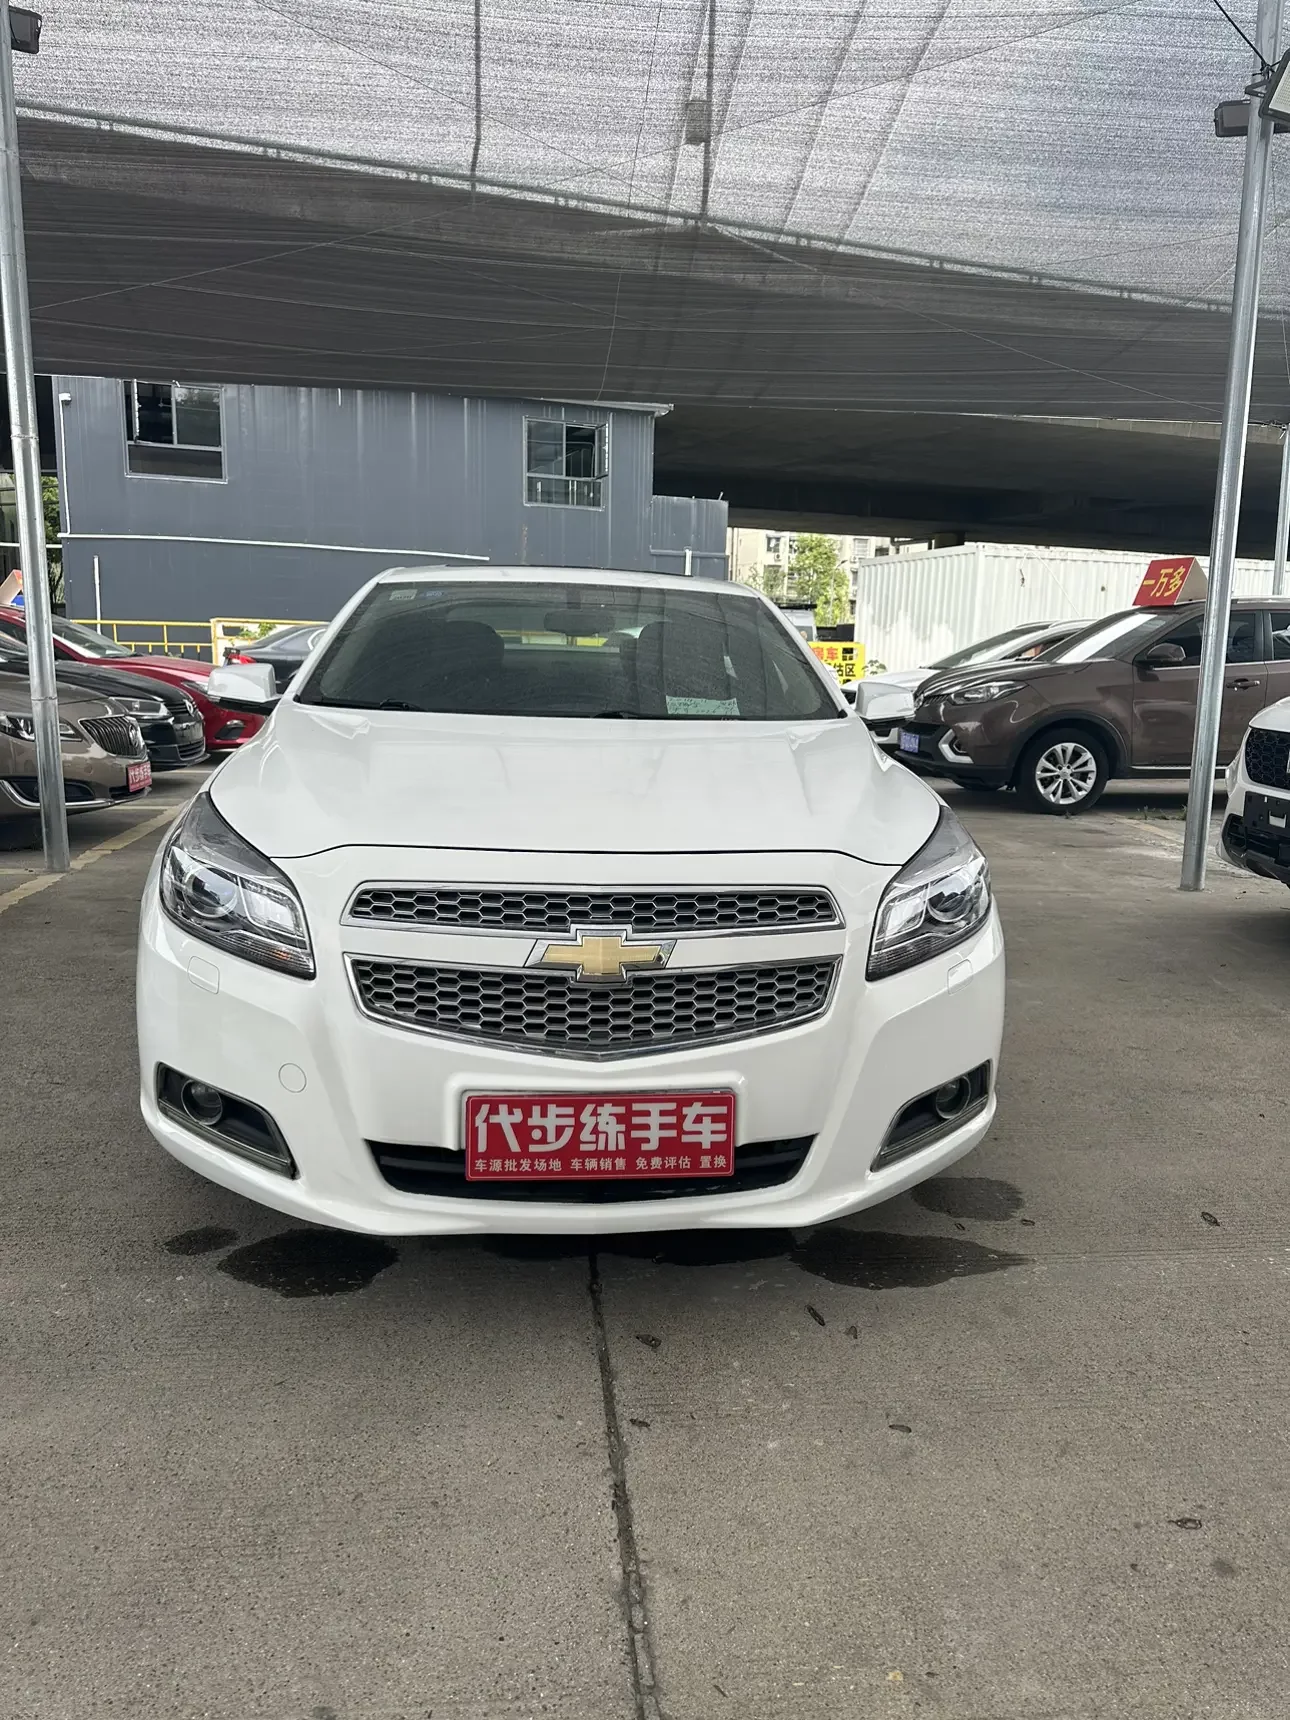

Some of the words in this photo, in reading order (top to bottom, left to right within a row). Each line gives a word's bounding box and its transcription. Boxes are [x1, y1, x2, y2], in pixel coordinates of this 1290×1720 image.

[1143, 566, 1186, 597] 一万多
[475, 1102, 728, 1153] 代步练手车
[475, 1158, 562, 1172] 车源批发场地
[571, 1157, 627, 1171] 车辆销售
[635, 1156, 691, 1170] 免费评估
[699, 1155, 727, 1168] 置换
